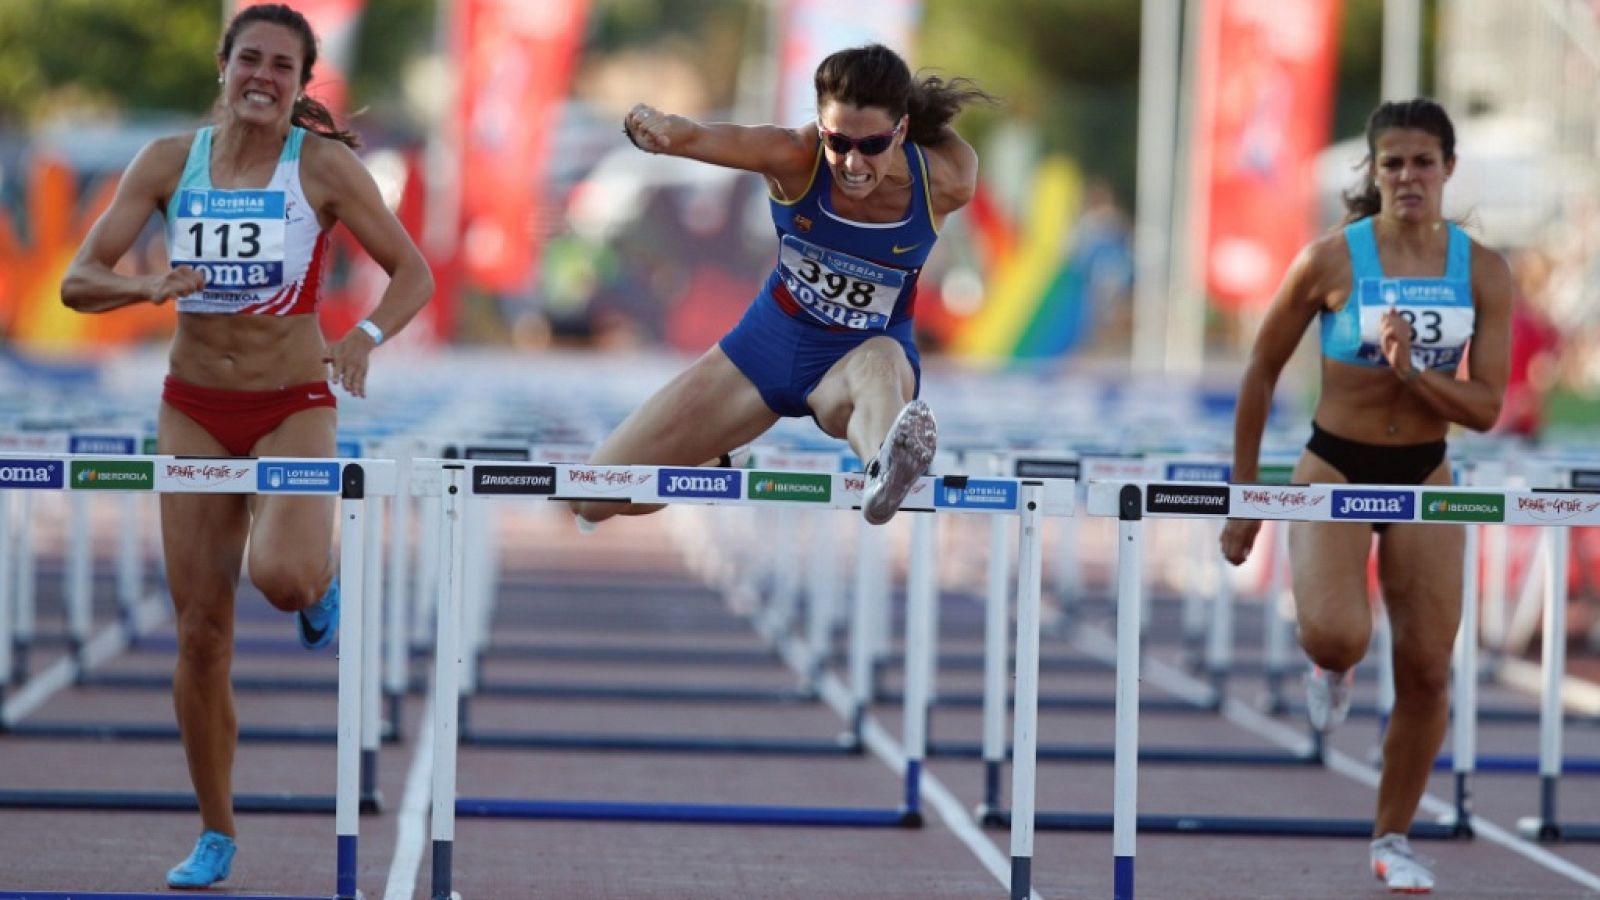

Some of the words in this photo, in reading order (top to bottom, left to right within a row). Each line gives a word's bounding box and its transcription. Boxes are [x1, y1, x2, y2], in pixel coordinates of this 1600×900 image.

[189, 222, 261, 258] 113
[798, 259, 875, 308] 398
[98, 472, 147, 480] IBERDROLA
[287, 469, 329, 477] LOTERÍAS
[481, 474, 552, 486] BRIDGESTONE
[774, 483, 825, 493] IBERDROLA
[1155, 493, 1225, 506] BRIDGESTONE
[1448, 503, 1498, 513] IBERDROLA
